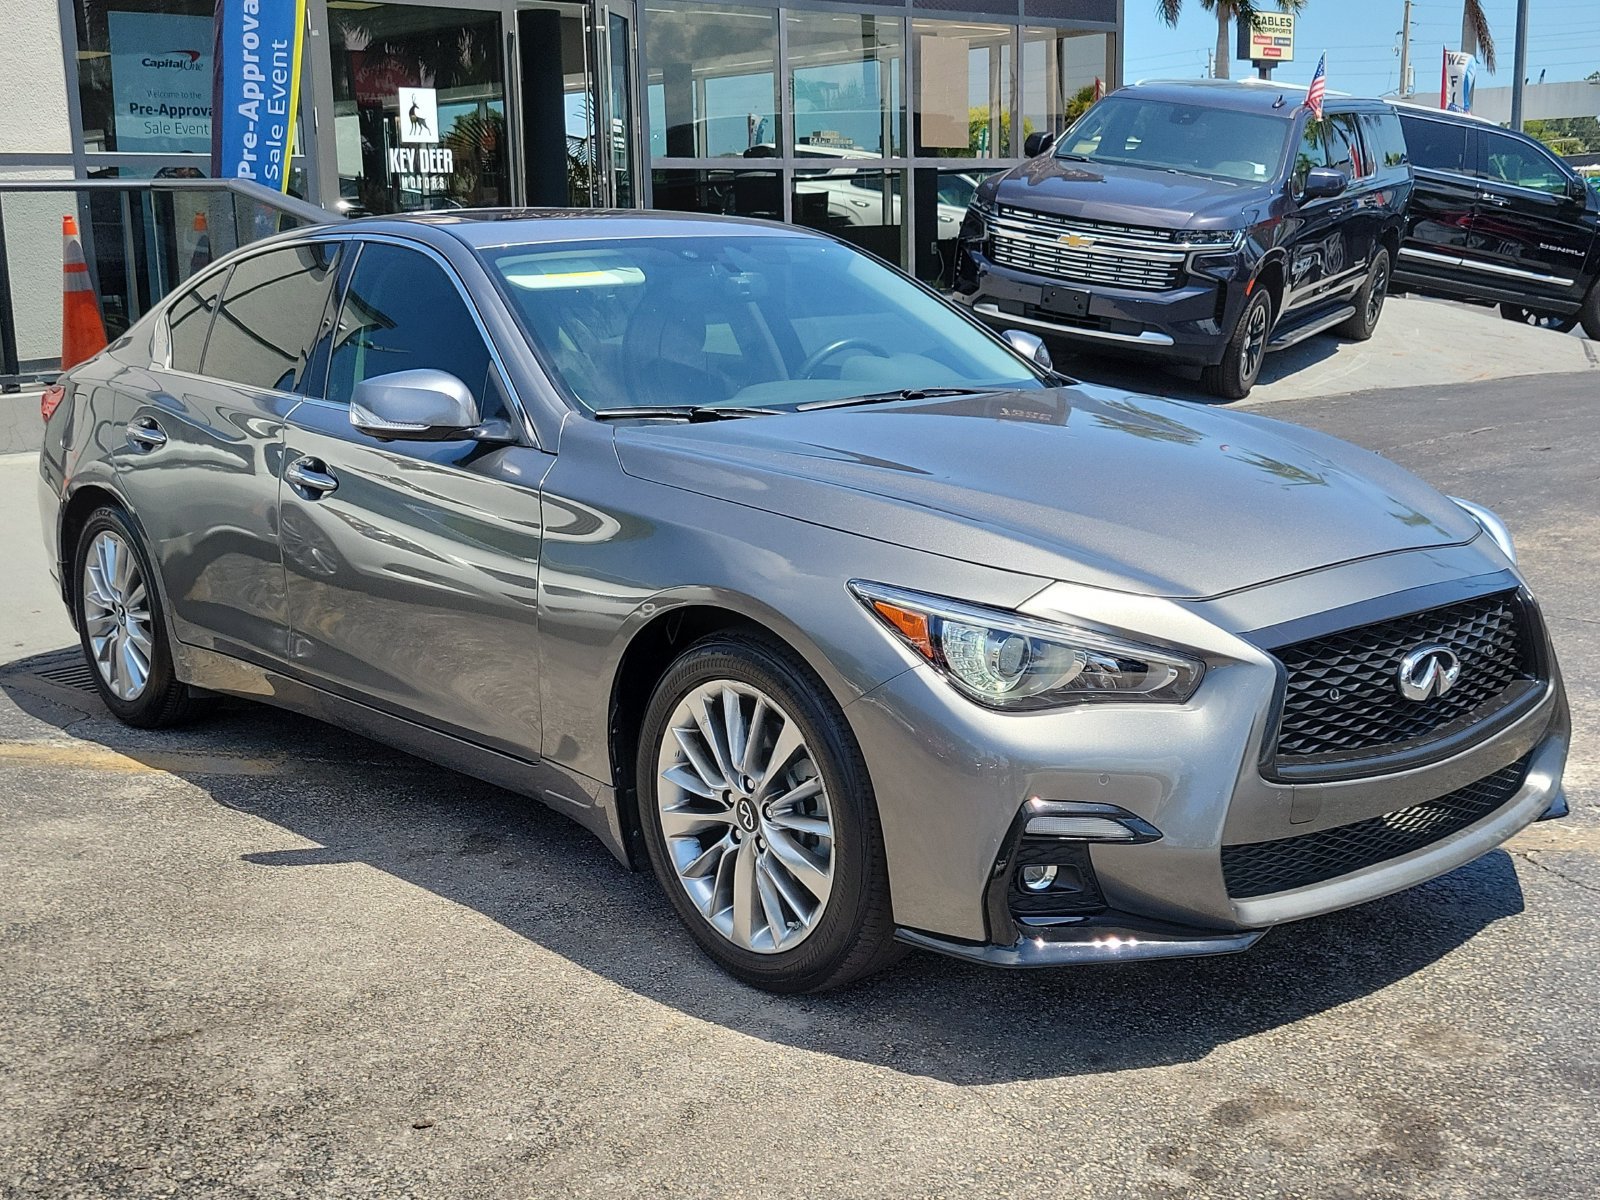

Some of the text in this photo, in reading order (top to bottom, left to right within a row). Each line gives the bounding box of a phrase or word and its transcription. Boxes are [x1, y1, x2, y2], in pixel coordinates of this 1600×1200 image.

[1447, 53, 1468, 66] WE
[147, 90, 202, 100] Welcome to the
[264, 39, 288, 180] Sale Event
[144, 121, 209, 136] Sale Event
[389, 147, 454, 174] KEY DEER
[401, 175, 446, 189] MOTORS
